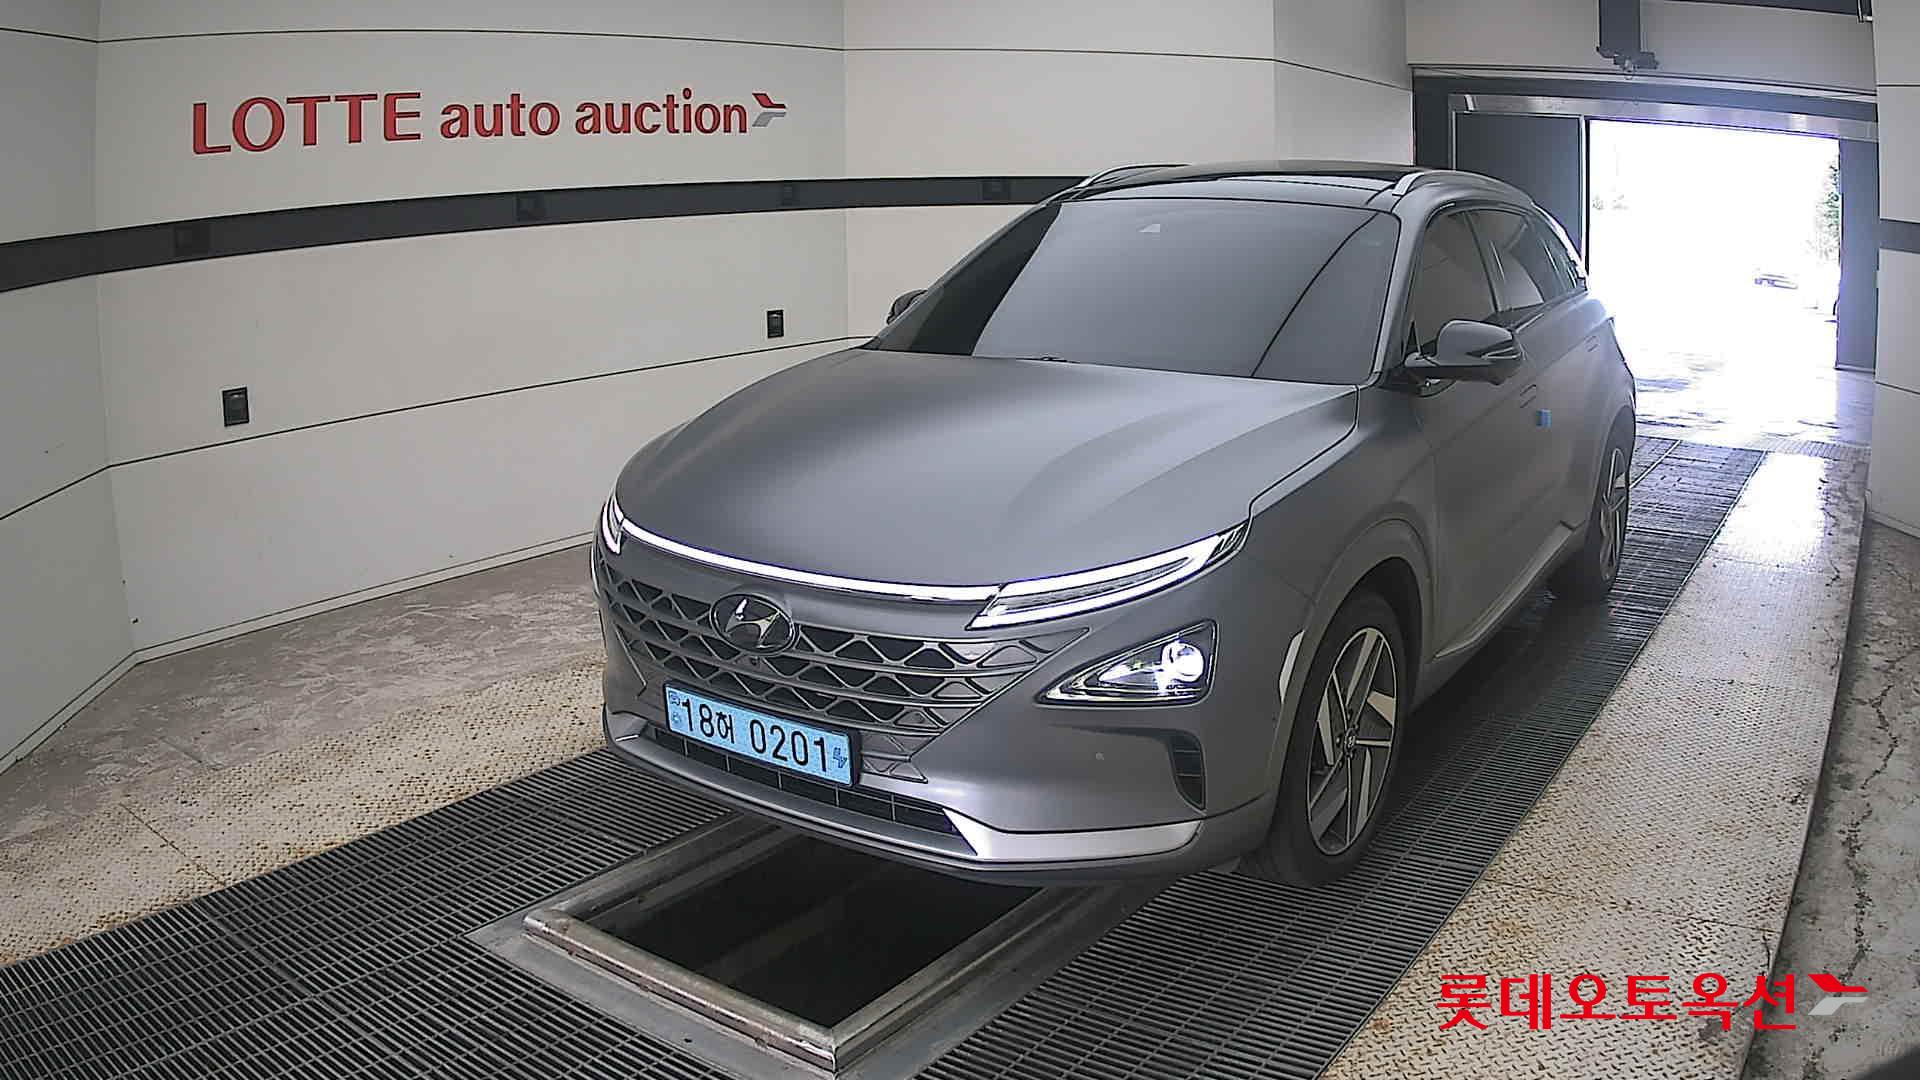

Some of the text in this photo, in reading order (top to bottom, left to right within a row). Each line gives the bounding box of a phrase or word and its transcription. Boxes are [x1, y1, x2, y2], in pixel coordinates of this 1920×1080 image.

[192, 88, 748, 155] LOTTE auto auction
[681, 698, 735, 744] 18허
[749, 718, 828, 773] 0201
